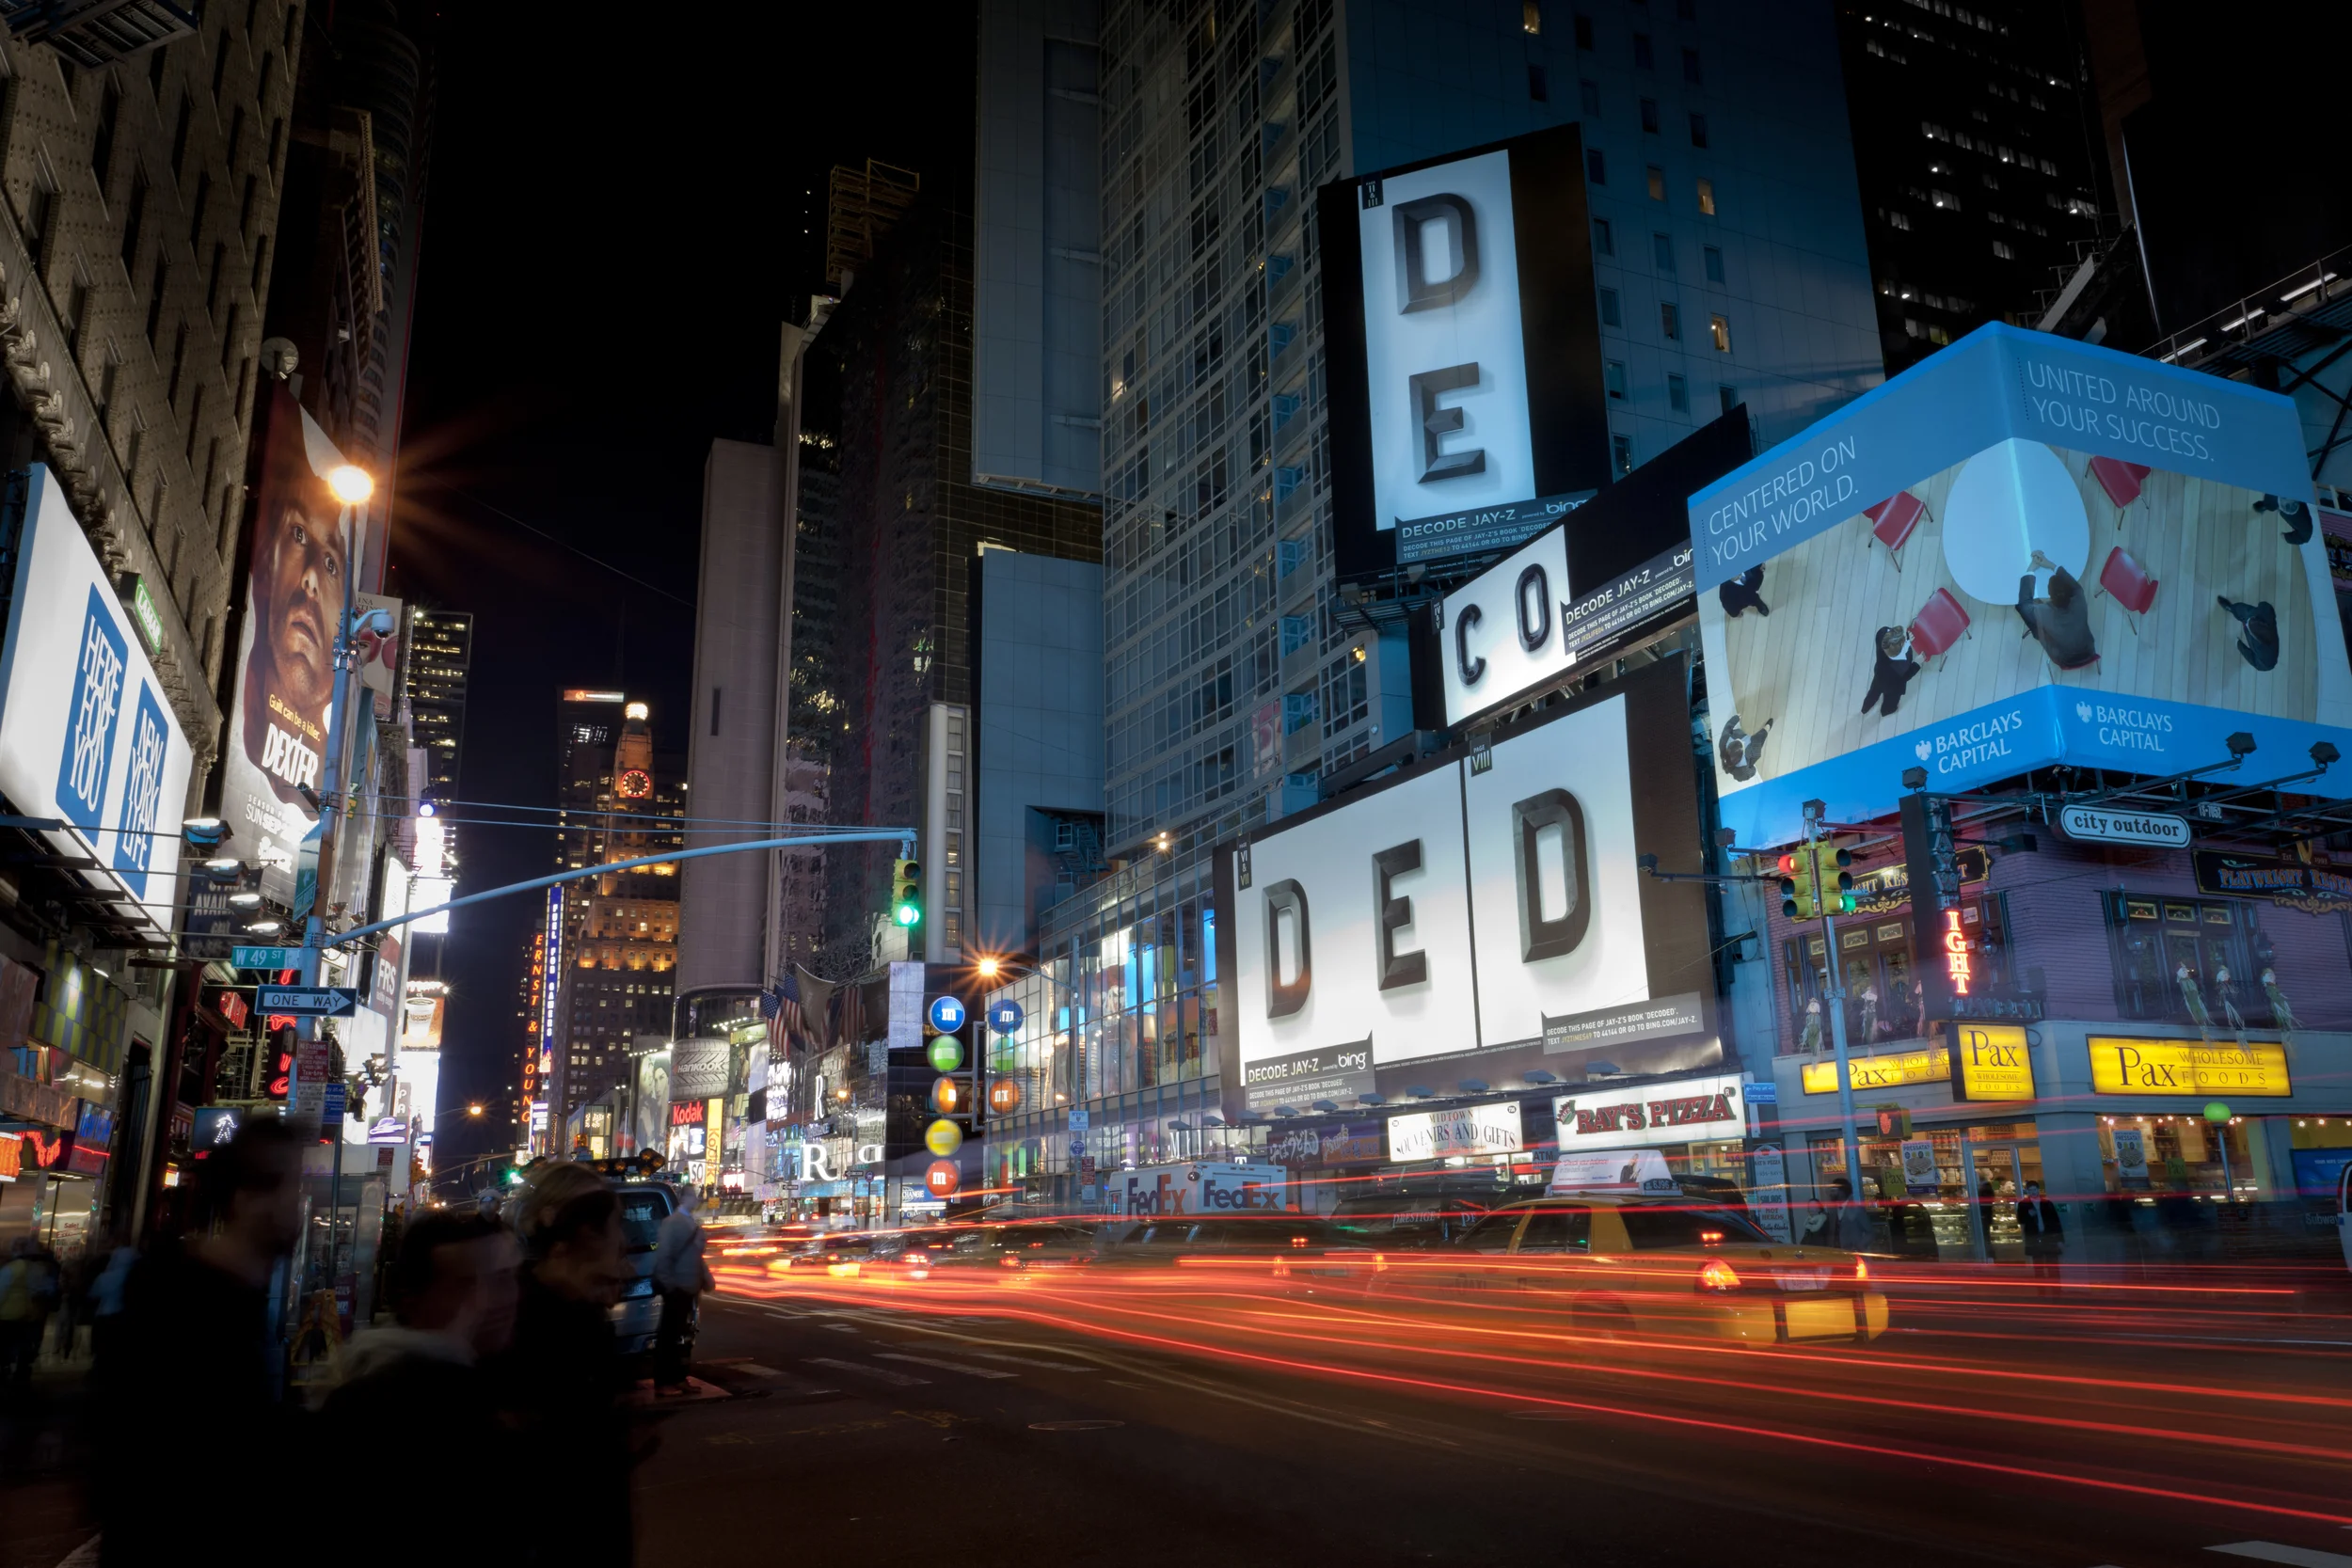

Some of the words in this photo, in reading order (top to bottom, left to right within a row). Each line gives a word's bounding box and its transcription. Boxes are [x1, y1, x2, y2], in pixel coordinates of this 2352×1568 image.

[2027, 360, 2116, 404] UNITED
[2126, 386, 2220, 429] AROUND
[2032, 396, 2102, 436] YOUR
[2106, 414, 2215, 462] SUCCESS.
[1709, 461, 1815, 535] CENTERED
[1821, 436, 1855, 473] ON
[1402, 517, 1467, 538] DECODE
[1471, 509, 1516, 526] JAY-Z
[1711, 521, 1768, 565] YOUR
[1771, 475, 1859, 534] WORLD.
[1404, 542, 1429, 552] DECODE
[1429, 539, 1445, 547] THIS
[1446, 536, 1462, 545] PAGE
[1464, 534, 1472, 543] OF
[1500, 528, 1518, 536] BOOK
[1565, 590, 1613, 625] DECODE
[1617, 569, 1650, 597] JAY-Z
[137, 590, 161, 642] LAMAR
[1568, 627, 1586, 641] DECODE
[1587, 620, 1598, 629] THIS
[1598, 614, 1612, 626] PAGE
[1639, 593, 1653, 604] BOOK
[1568, 639, 1581, 648] TEXT
[1604, 622, 1612, 630] TO
[1626, 611, 1633, 620] OR
[1642, 603, 1649, 611] TO
[83, 615, 122, 717] HERE
[77, 676, 111, 762] FOR
[269, 693, 284, 714] Guilt
[283, 707, 294, 722] can
[294, 713, 302, 727] be
[302, 721, 307, 731] a
[307, 720, 321, 741] killer.
[1936, 710, 2023, 754] BARCLAYS
[2096, 705, 2173, 733] BARCLAYS
[136, 707, 164, 783] NEW
[1938, 738, 2011, 774] CAPITAL
[2099, 727, 2165, 752] CAPITAL
[70, 724, 104, 812] YOU
[262, 722, 319, 791] DEXTER
[1471, 750, 1490, 771] VIII
[129, 747, 159, 835] YORK
[246, 803, 263, 826] SUN
[2074, 813, 2107, 835] city
[2113, 816, 2180, 837] outdoor
[121, 800, 148, 871] LIFE
[1512, 787, 1592, 964] D
[2217, 868, 2303, 889] PLAYWRIGHT
[550, 903, 559, 940] FUEL
[236, 949, 246, 965] W
[250, 949, 267, 965] 49
[271, 950, 282, 958] ST
[532, 934, 544, 1006] ERNST
[376, 958, 397, 996] FRS
[272, 994, 299, 1006] ONE
[313, 996, 342, 1007] WAY
[942, 1008, 957, 1022] m
[528, 1021, 538, 1032] &
[1547, 1026, 1568, 1036] DECODE
[1568, 1023, 1581, 1033] THIS
[1581, 1022, 1597, 1031] PAGE
[1628, 1013, 1645, 1023] BOOK
[1547, 1037, 1561, 1046] TEXT
[1968, 1030, 2019, 1068] Pax
[1248, 1063, 1288, 1083] DECODE
[1291, 1057, 1319, 1076] JAY-Z
[1338, 1052, 1367, 1069] bing
[1976, 1072, 2020, 1081] WHOLESOME
[2115, 1047, 2178, 1087] Pax
[2177, 1051, 2265, 1066] WHOLESOME
[2182, 1070, 2265, 1085] FOODS
[521, 1047, 535, 1123] YOUNG
[1249, 1090, 1264, 1100] DECODE
[1264, 1088, 1274, 1097] THIS
[1274, 1086, 1285, 1096] PAGE
[1308, 1082, 1320, 1090] BOOK
[1978, 1083, 2021, 1091] FOODS
[673, 1101, 704, 1125] Kodak
[1249, 1101, 1259, 1109] TEXT
[1428, 1109, 1474, 1123] MIDTOWN
[1576, 1102, 1646, 1135] RAY'S
[1648, 1094, 1737, 1128] PIZZA
[1454, 1123, 1478, 1140] AND
[1484, 1125, 1516, 1149] GIFTS
[800, 1144, 838, 1181] R
[1534, 1150, 1553, 1161] ATM
[932, 1172, 946, 1185] m
[1128, 1174, 1187, 1216] FedEx
[1204, 1180, 1279, 1210] FedEx
[1760, 1195, 1782, 1203] SALADS
[1392, 1211, 1436, 1229] PRESTIGE
